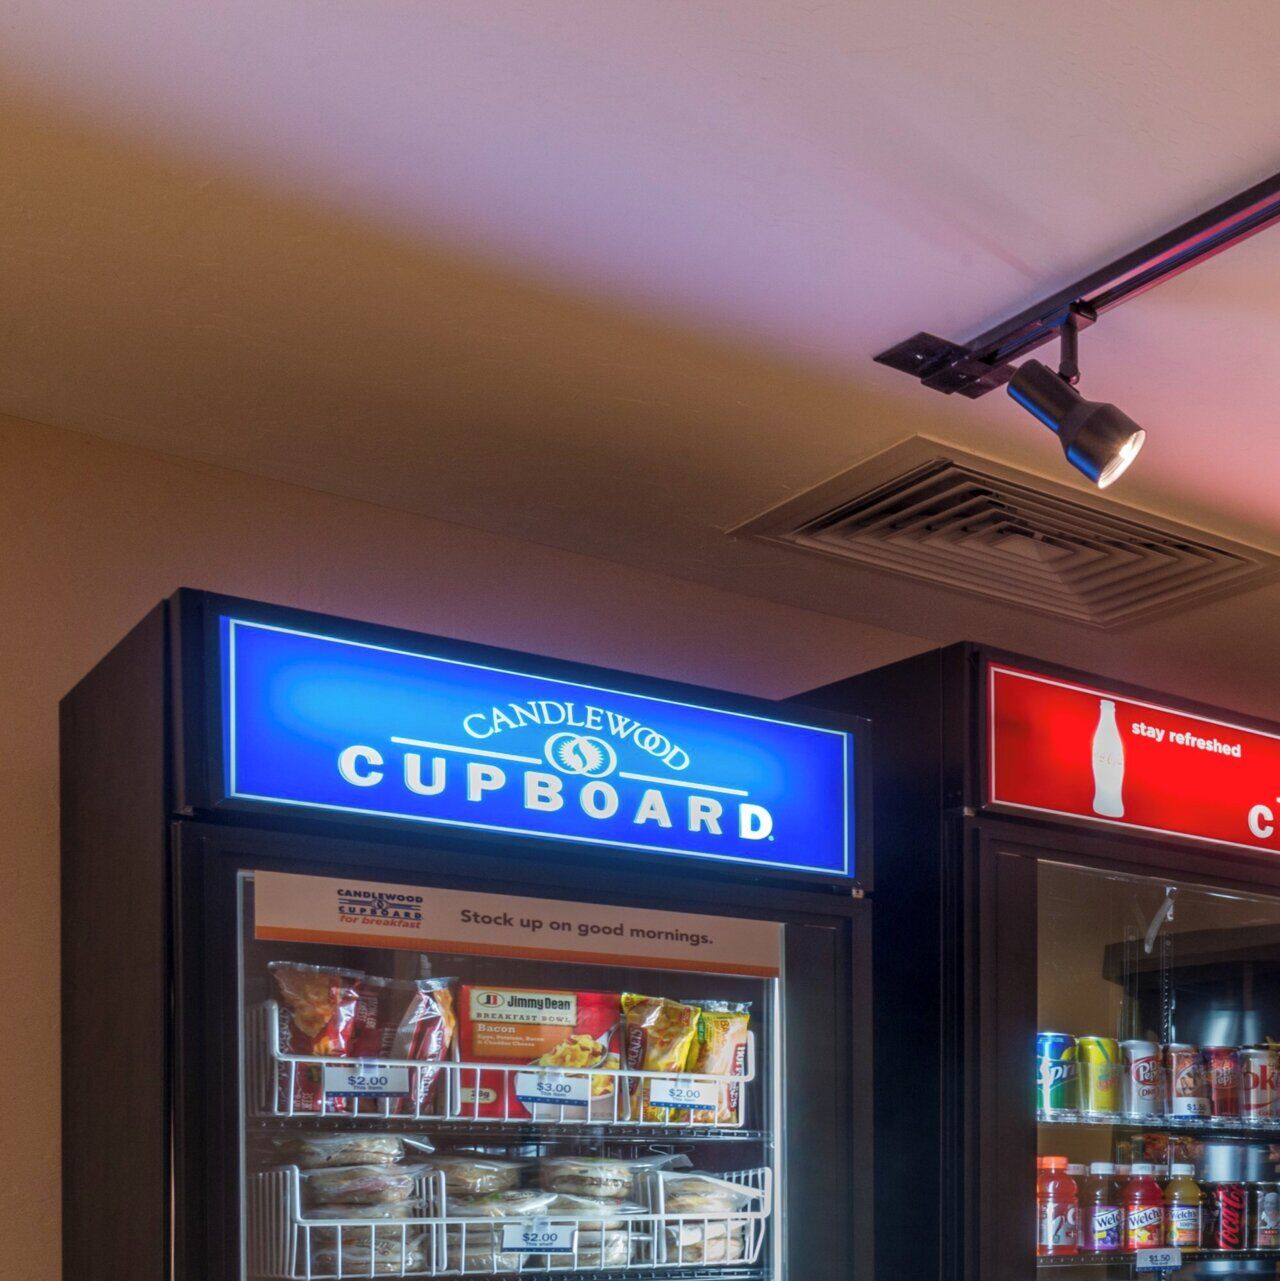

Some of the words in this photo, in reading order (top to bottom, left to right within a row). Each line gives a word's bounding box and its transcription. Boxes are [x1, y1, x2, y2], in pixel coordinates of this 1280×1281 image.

[462, 701, 690, 772] CANDLEWOOD
[1132, 722, 1165, 742] stay
[1169, 731, 1242, 758] refreshed
[338, 745, 775, 841] CUPBOARD
[337, 889, 424, 903] CANDLEWOOD
[338, 904, 424, 920] CUPBOARD
[339, 914, 360, 925] for
[362, 916, 421, 929] breakfast
[460, 909, 513, 927] Stock
[519, 916, 543, 932] up
[549, 920, 572, 932] on
[577, 921, 624, 940] good
[630, 927, 714, 948] mornings.
[507, 990, 544, 1010] Jimmy
[545, 995, 571, 1011] Dean
[476, 1012, 538, 1022] BREAKFAST
[541, 1014, 571, 1024] BOWL
[477, 1023, 516, 1034] Bacon
[347, 1075, 389, 1087] $2.00
[536, 1082, 572, 1094] $3.00
[668, 1088, 701, 1099] $2.00
[522, 1233, 558, 1244] $2.00
[1148, 1254, 1171, 1263] $1.50
